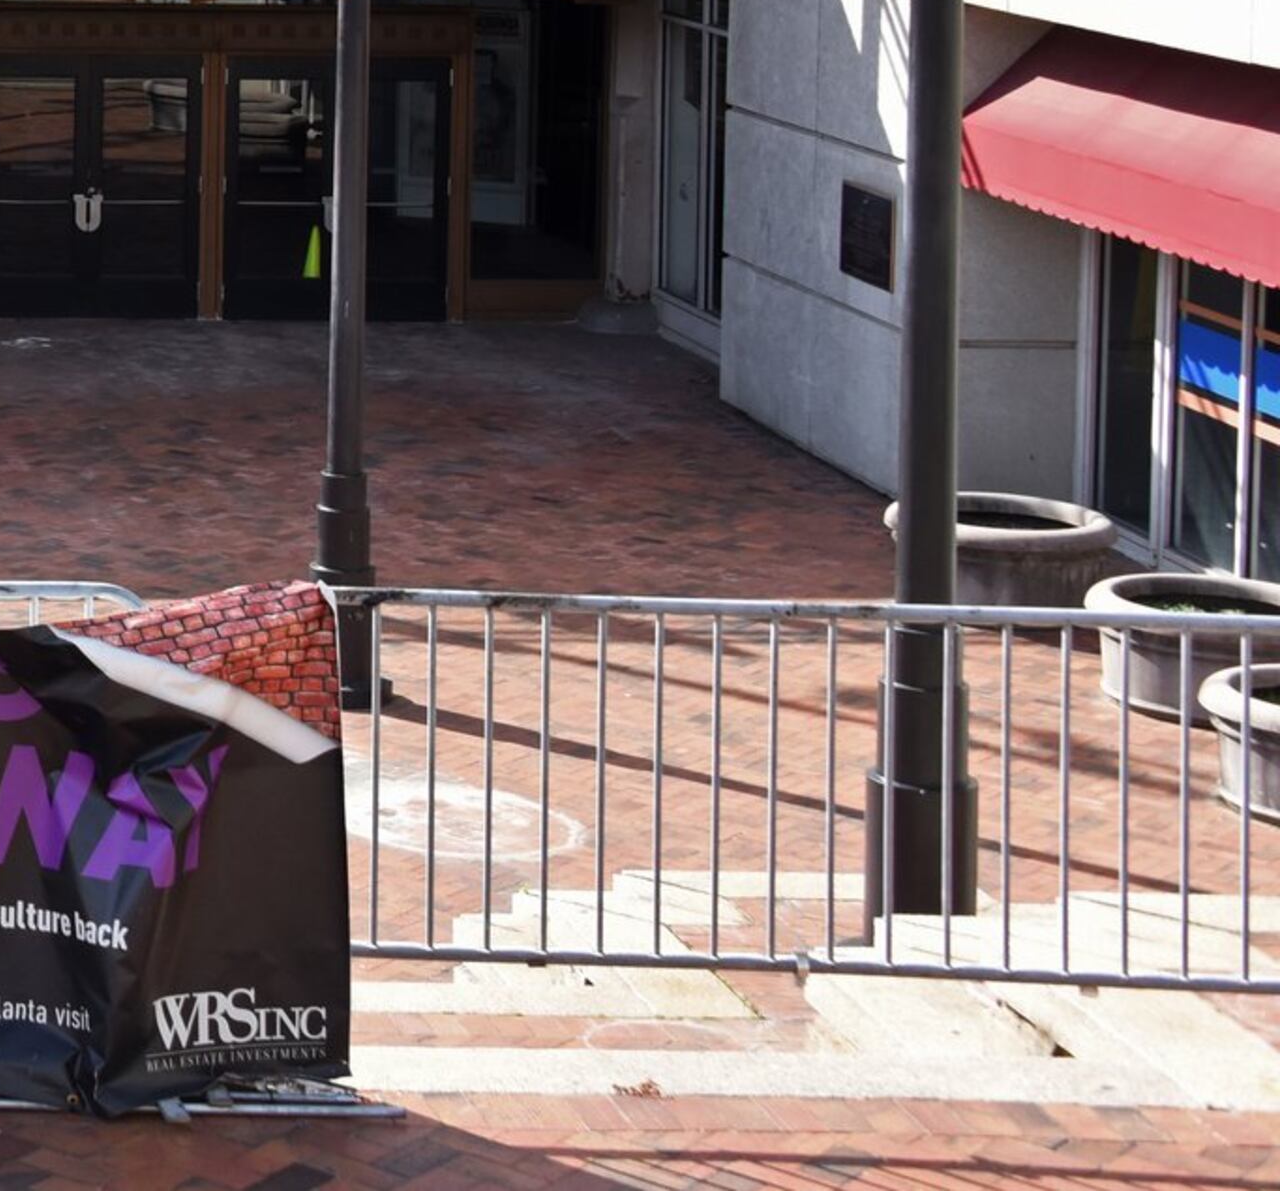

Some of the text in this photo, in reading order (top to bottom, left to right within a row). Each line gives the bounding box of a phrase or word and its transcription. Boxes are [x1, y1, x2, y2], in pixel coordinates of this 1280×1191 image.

[74, 911, 130, 951] back
[54, 1002, 92, 1033] visit
[145, 1046, 327, 1073] REAL ESTATE INVESTMENTS
